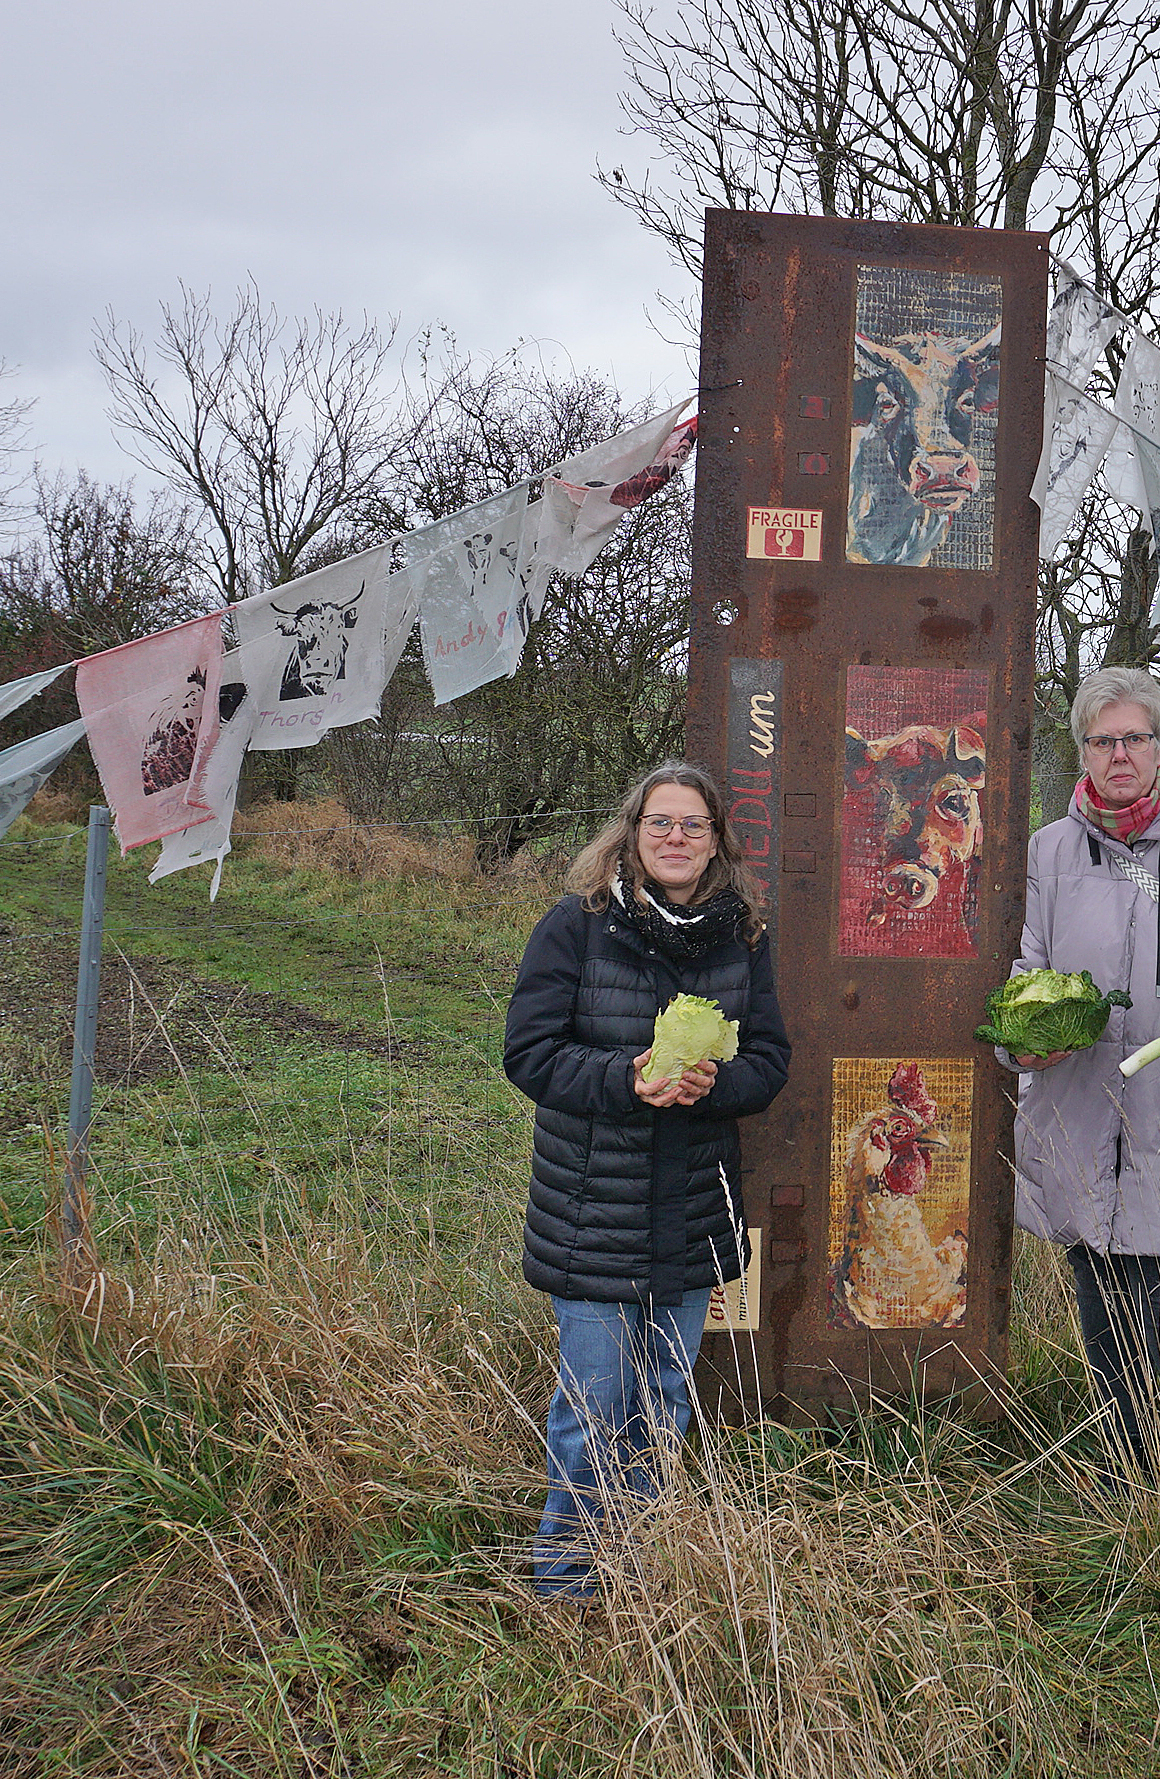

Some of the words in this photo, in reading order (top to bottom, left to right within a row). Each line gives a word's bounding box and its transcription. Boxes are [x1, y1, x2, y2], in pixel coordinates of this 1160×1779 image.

[804, 397, 825, 418] a
[751, 511, 819, 529] FRAGILE
[434, 620, 487, 658] Andy
